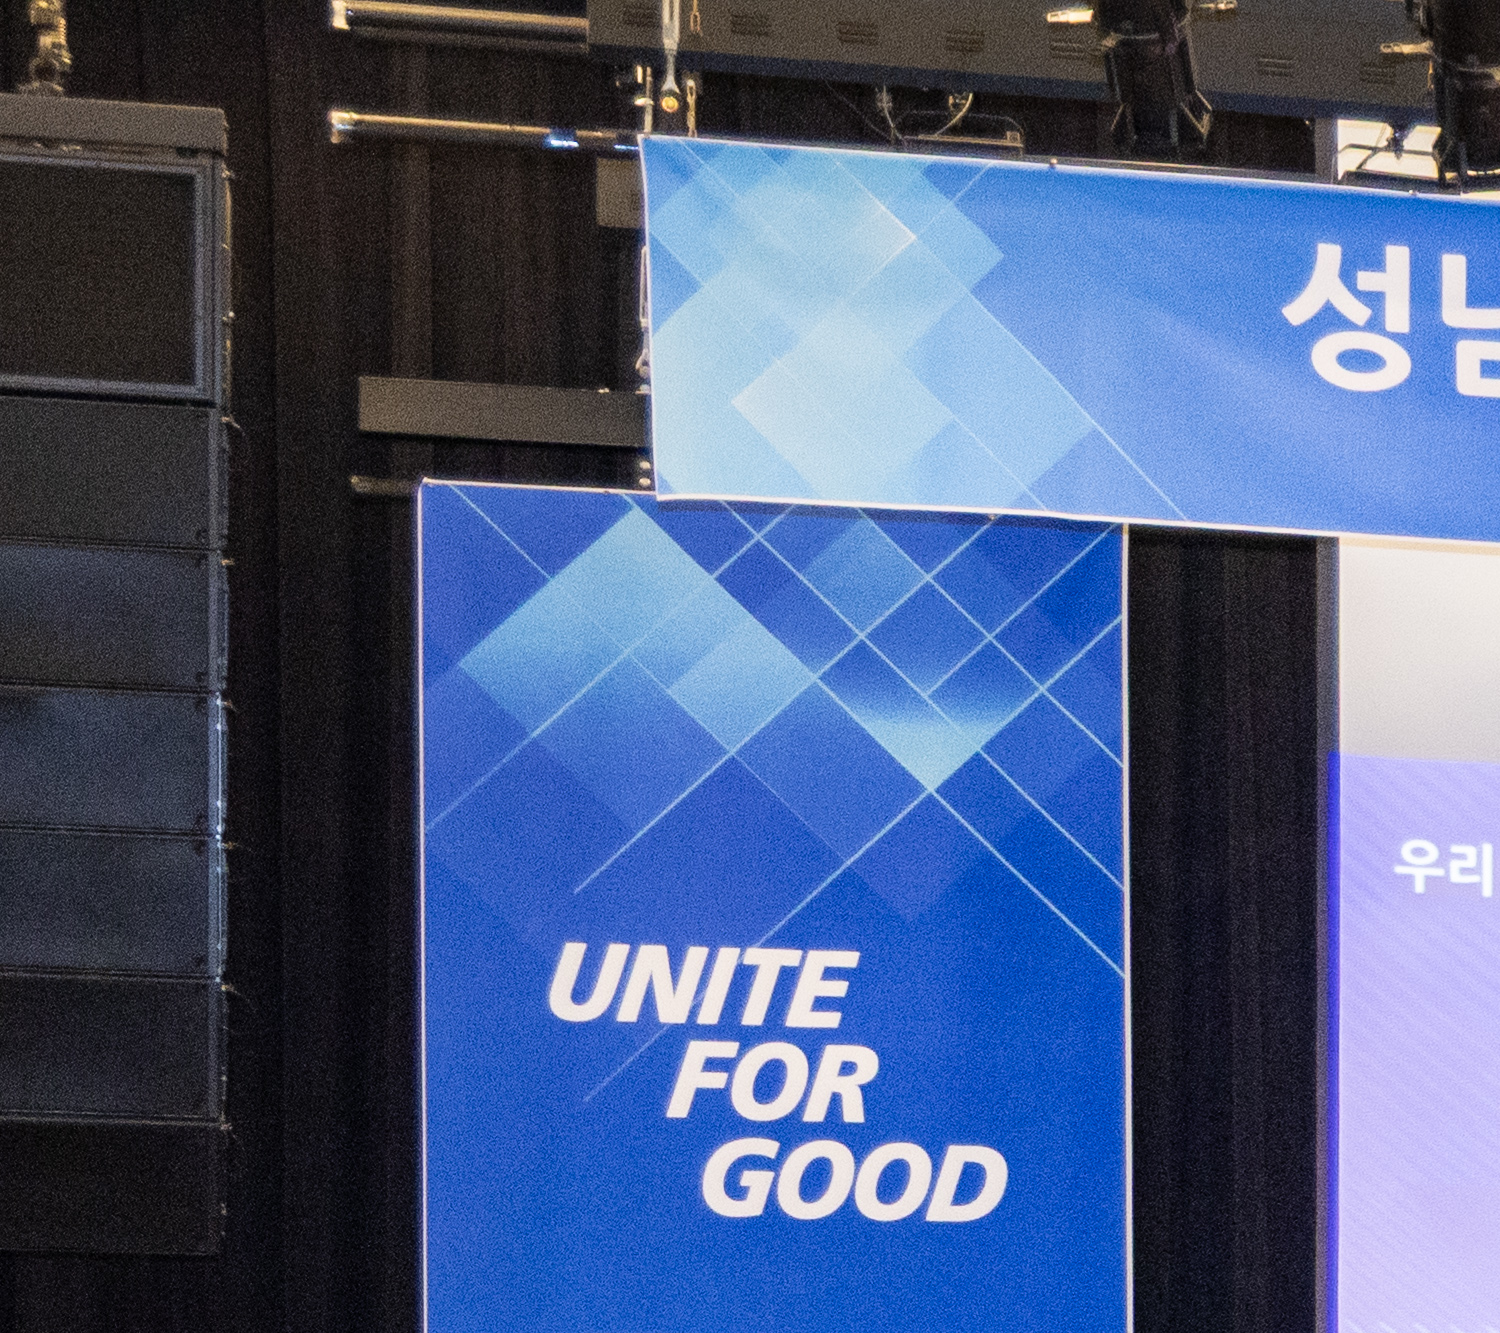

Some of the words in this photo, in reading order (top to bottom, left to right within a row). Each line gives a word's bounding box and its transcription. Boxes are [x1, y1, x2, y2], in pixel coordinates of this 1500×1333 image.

[1394, 840, 1492, 897] 우리
[549, 942, 860, 1028] UNITE
[666, 1040, 878, 1122] FOR
[702, 1138, 1007, 1222] GOOD
